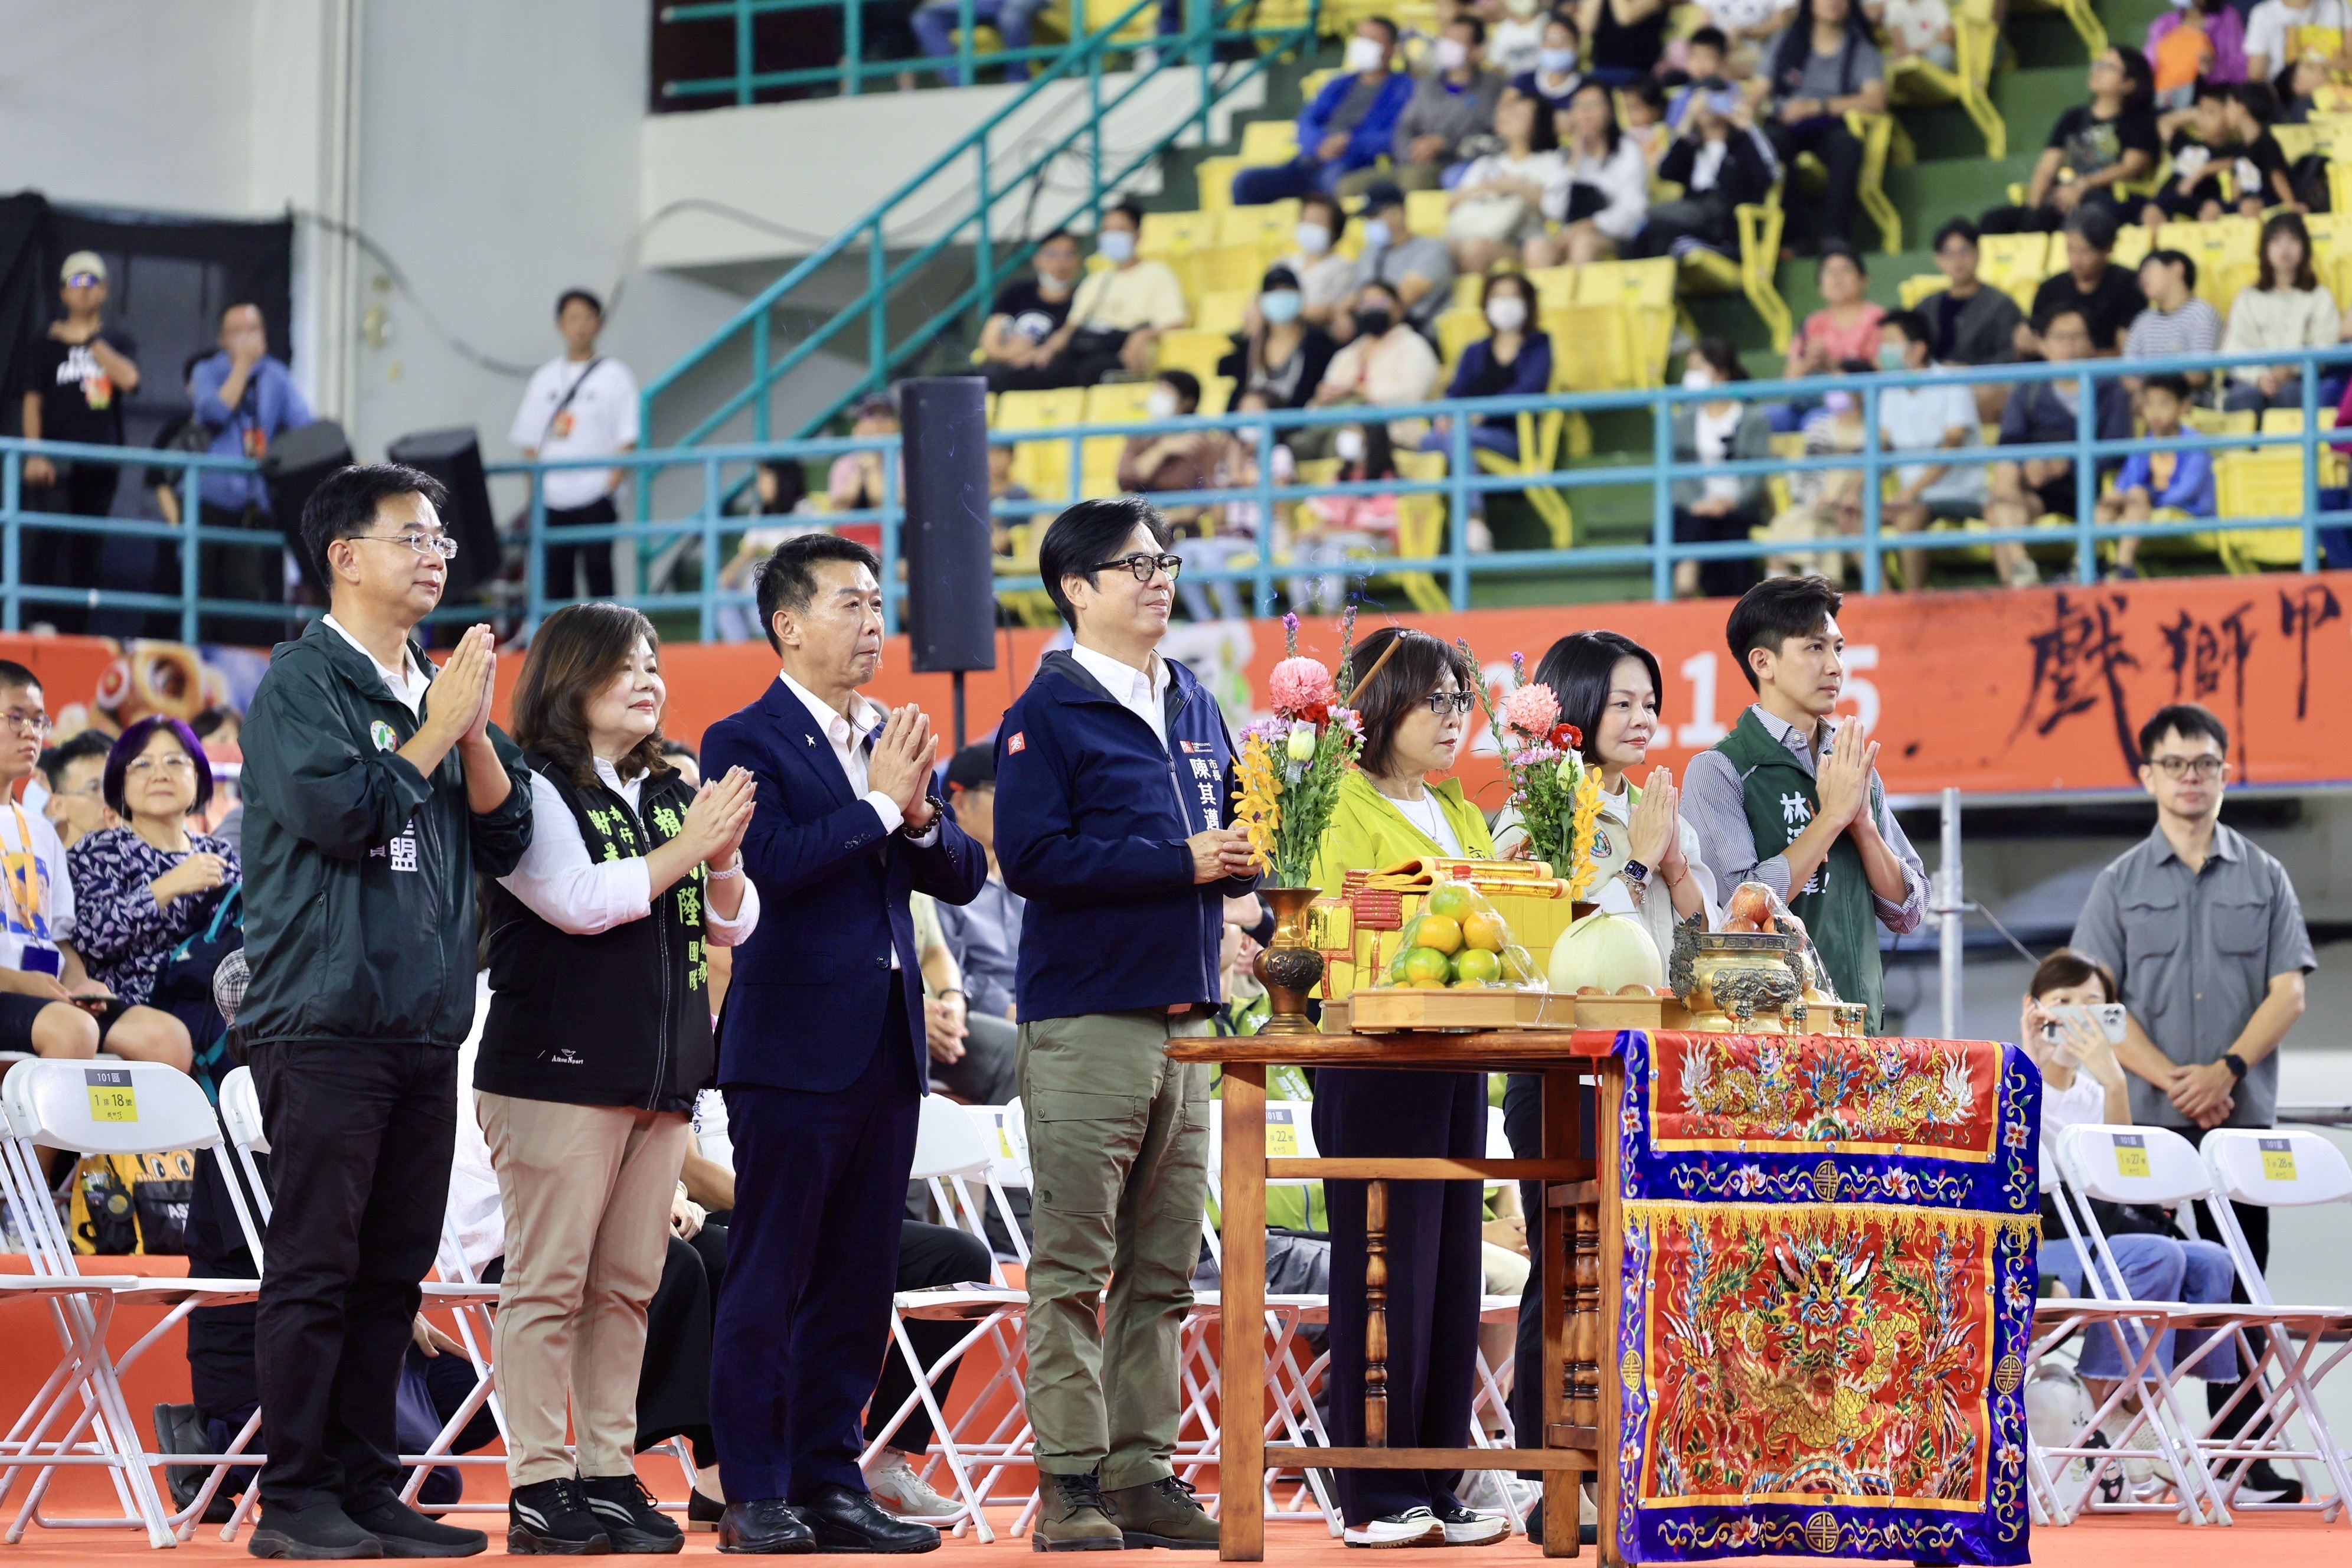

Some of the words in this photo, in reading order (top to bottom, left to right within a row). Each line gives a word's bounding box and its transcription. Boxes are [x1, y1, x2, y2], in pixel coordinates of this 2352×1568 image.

[1207, 758, 1222, 782] 市長
[1188, 757, 1220, 830] 陳其邁
[688, 941, 700, 991] 團隊
[97, 1073, 121, 1083] 101區
[94, 1094, 100, 1106] 1
[112, 1094, 124, 1106] 18
[1276, 1131, 1288, 1142] 22
